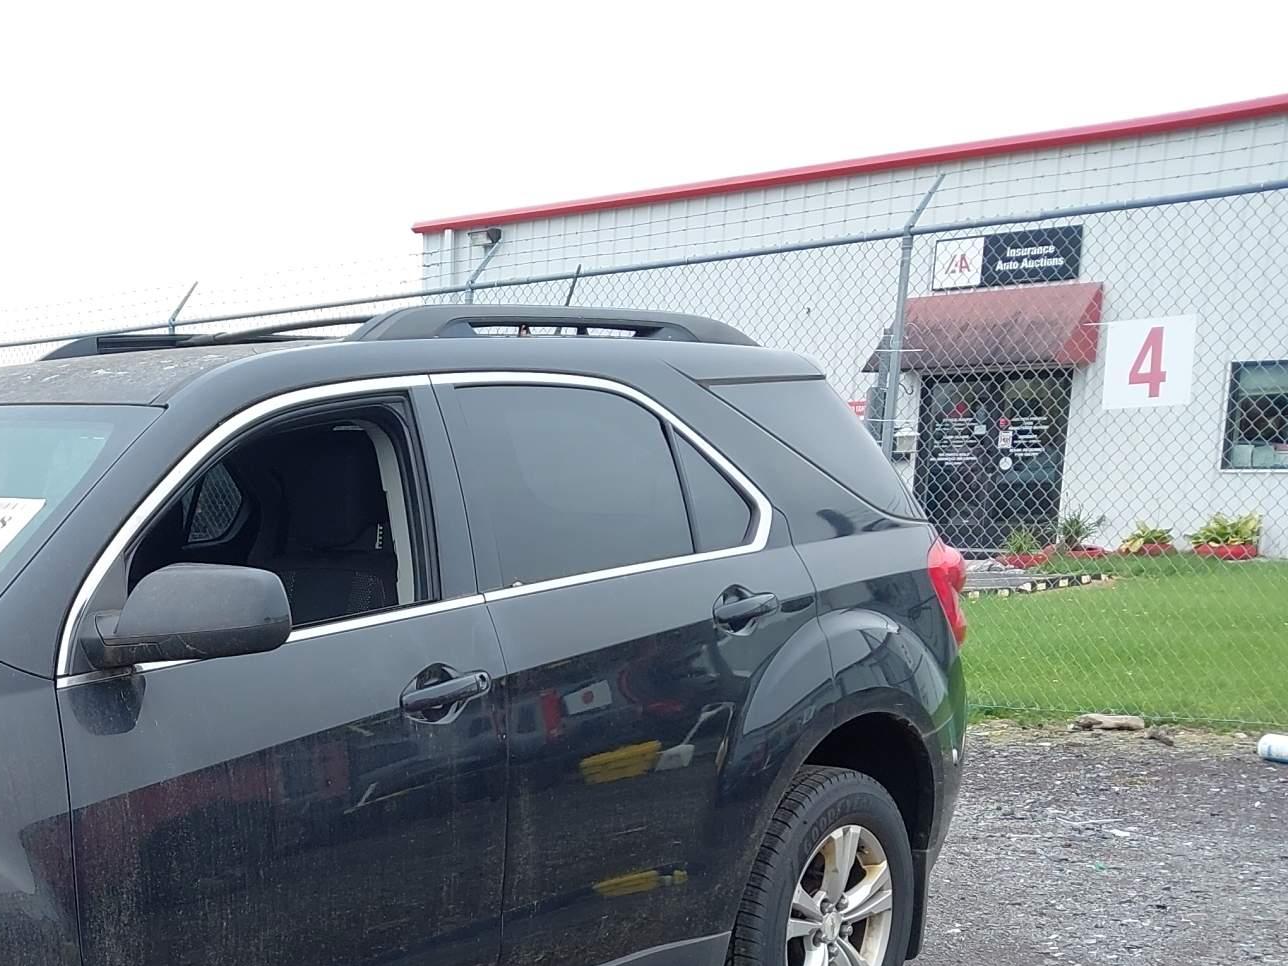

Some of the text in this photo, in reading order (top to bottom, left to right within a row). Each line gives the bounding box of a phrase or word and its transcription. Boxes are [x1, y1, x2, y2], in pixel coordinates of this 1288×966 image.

[1006, 244, 1056, 258] Insurance
[995, 255, 1065, 272] Auto Auctions
[1128, 326, 1167, 398] 4
